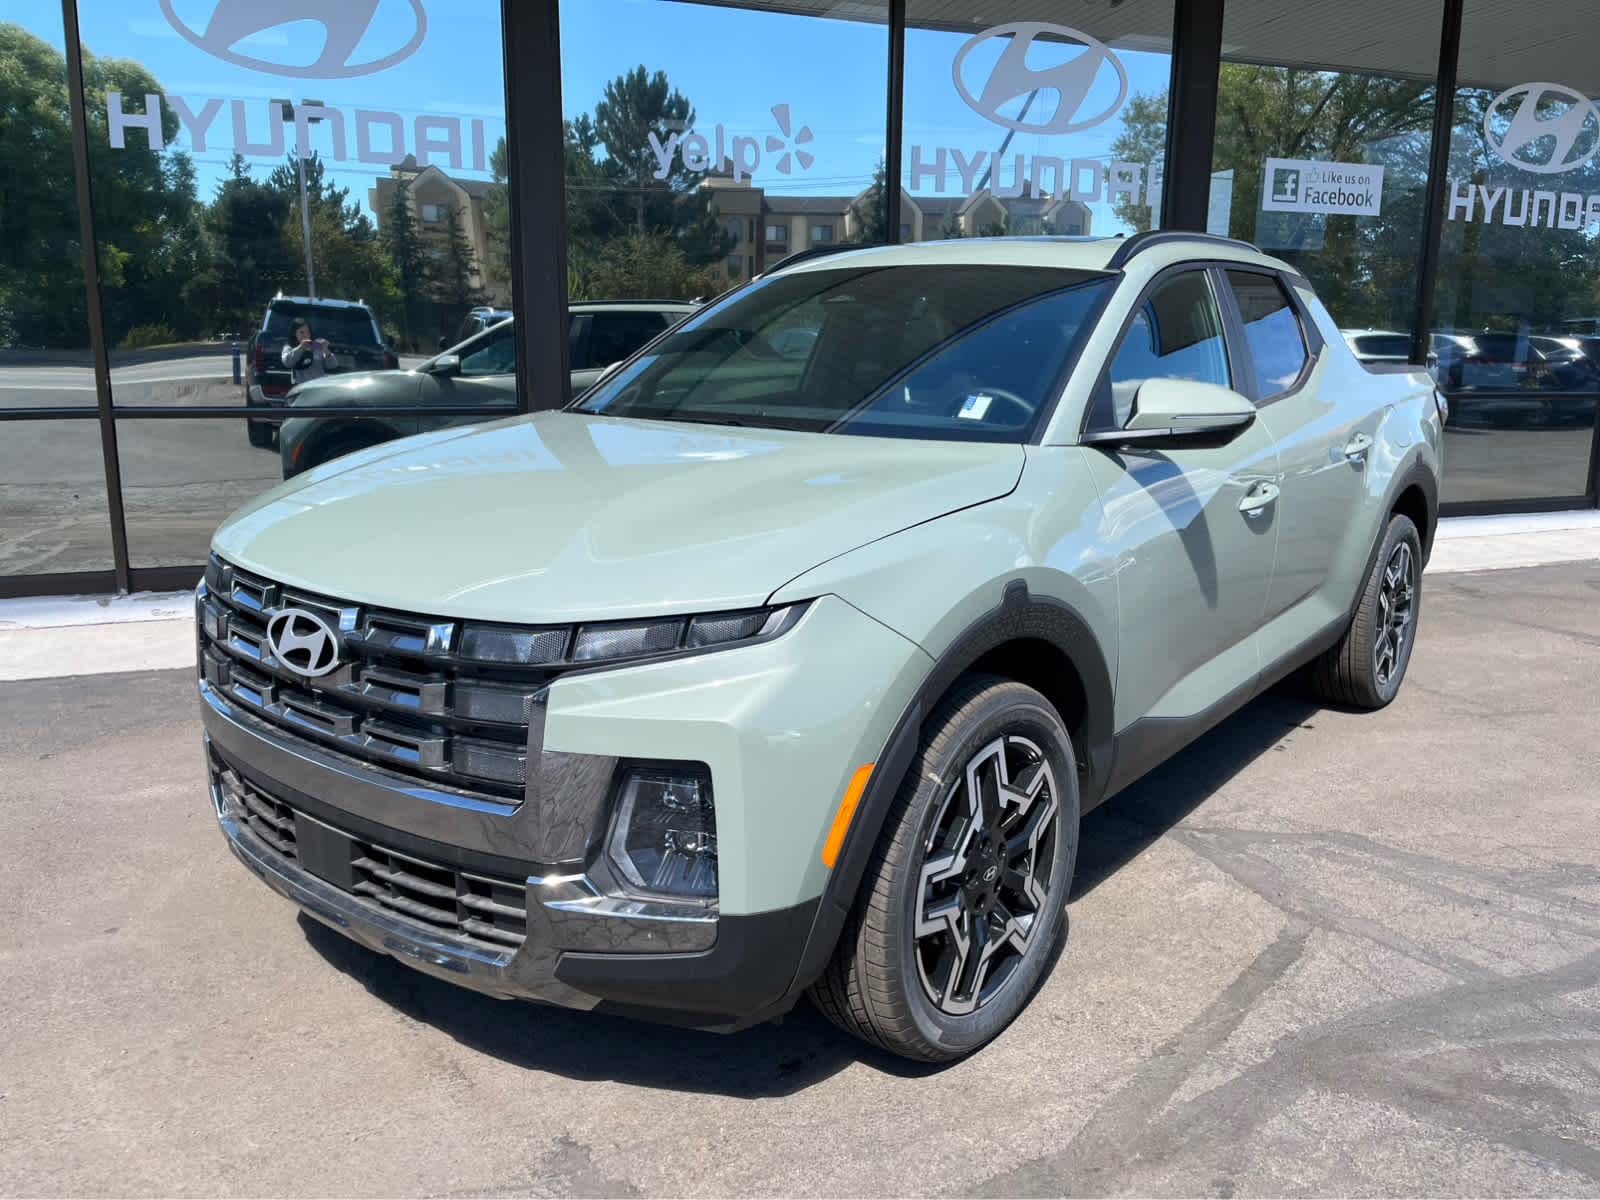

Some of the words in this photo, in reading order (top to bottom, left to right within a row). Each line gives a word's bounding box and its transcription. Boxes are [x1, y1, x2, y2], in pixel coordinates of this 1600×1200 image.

[106, 91, 486, 172] HYUNDAI
[647, 122, 761, 184] yelp
[910, 144, 1157, 207] HYUNDAI
[1304, 185, 1374, 208] Facebook
[1322, 170, 1343, 184] Like
[1345, 175, 1356, 185] us
[1358, 175, 1371, 185] on
